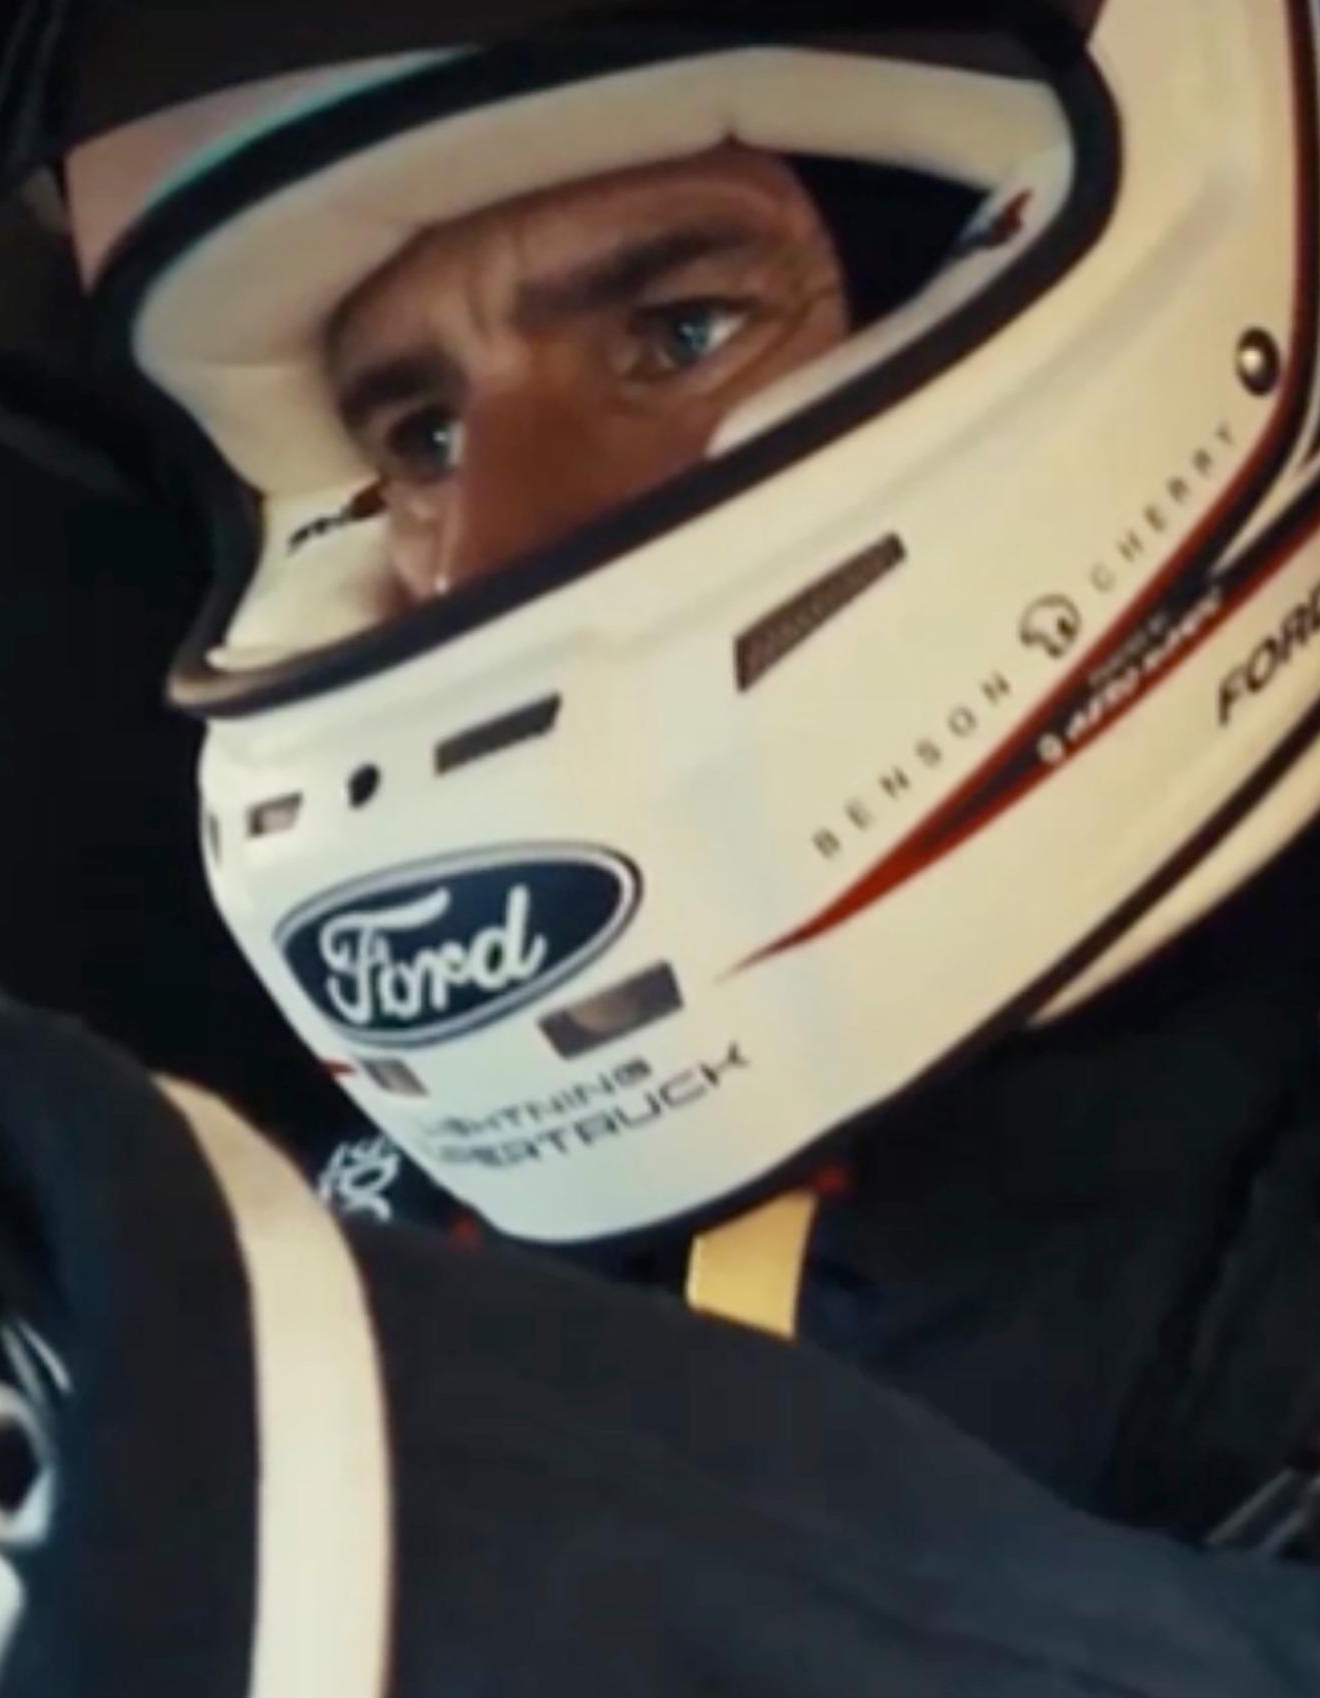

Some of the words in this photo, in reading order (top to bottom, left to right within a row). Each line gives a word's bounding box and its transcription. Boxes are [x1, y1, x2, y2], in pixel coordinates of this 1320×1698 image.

[812, 674, 1013, 860] BENSON
[1087, 420, 1239, 595] CHERRY
[319, 883, 547, 1024] Ford
